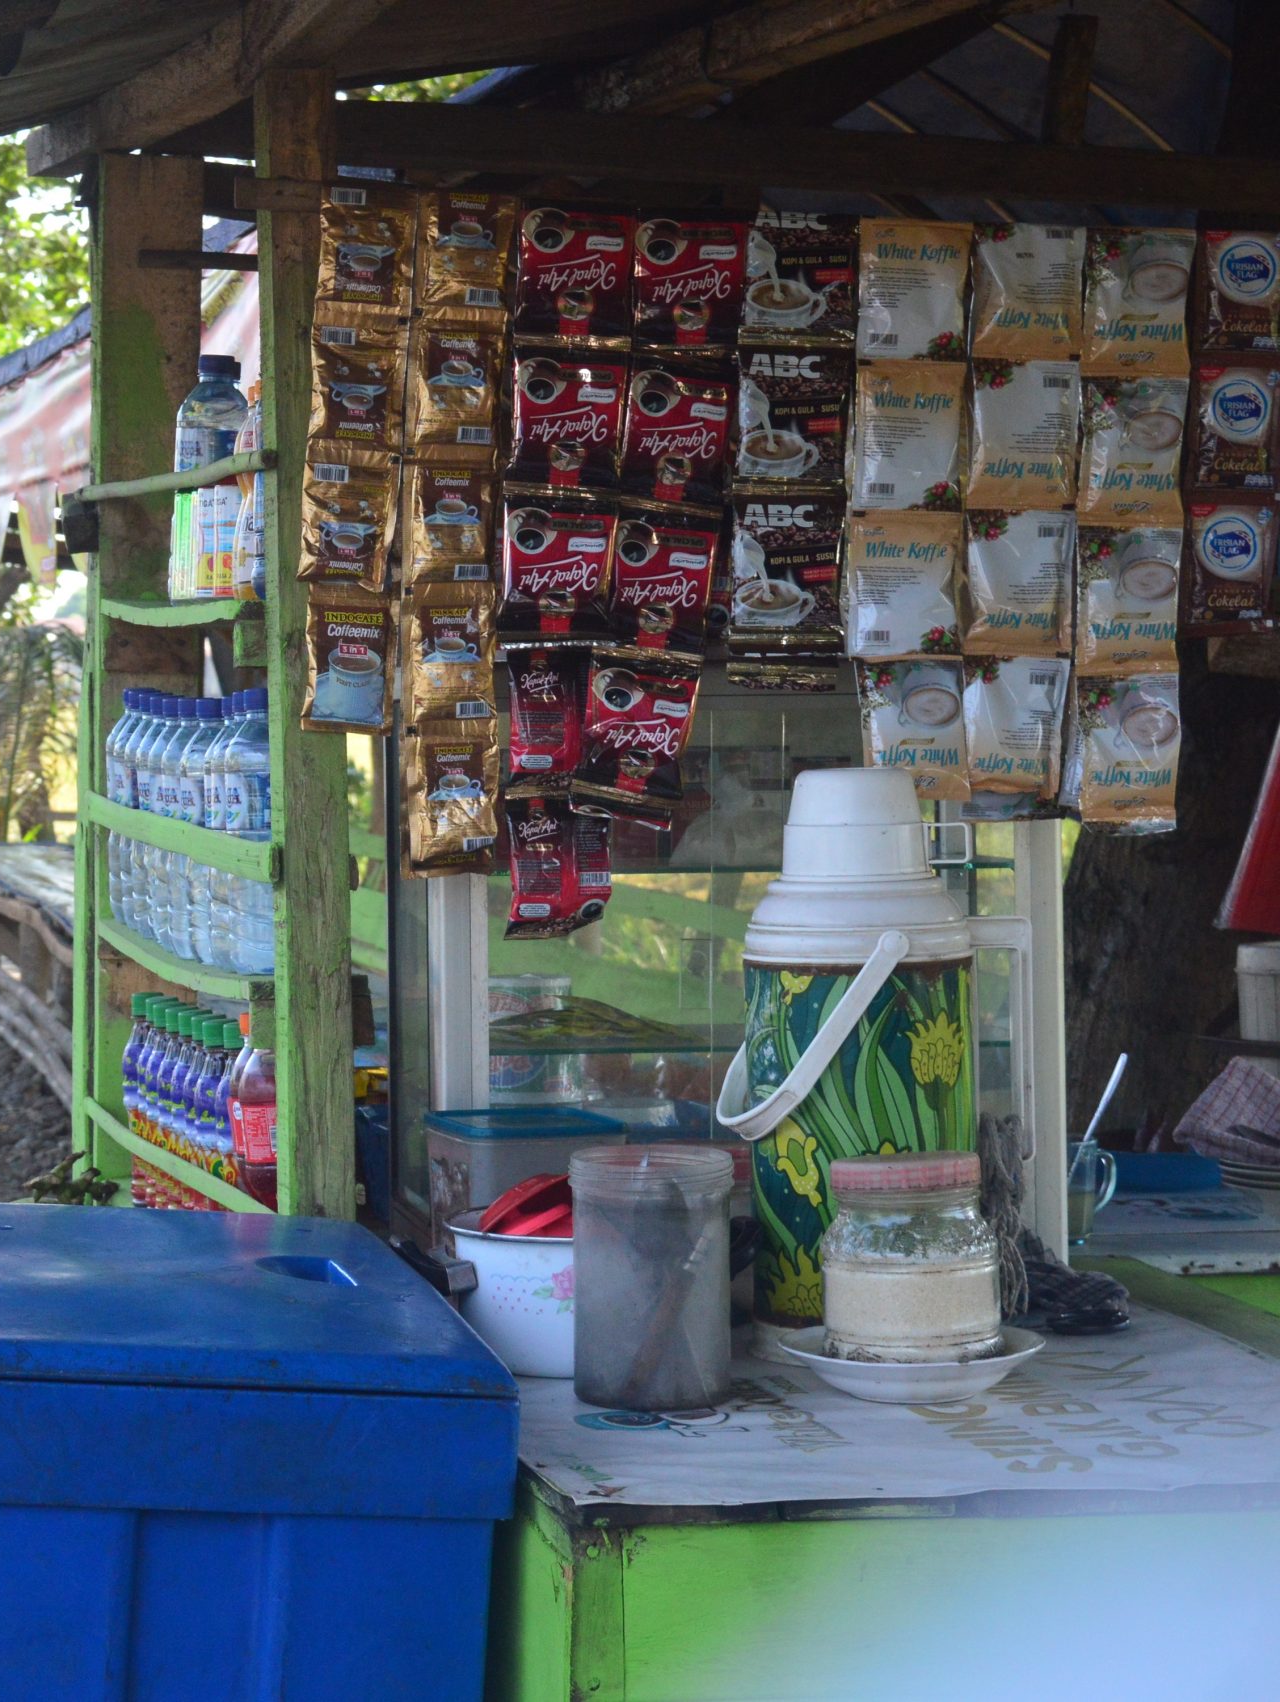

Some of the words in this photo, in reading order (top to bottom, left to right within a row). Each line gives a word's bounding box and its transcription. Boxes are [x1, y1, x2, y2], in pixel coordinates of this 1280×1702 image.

[451, 200, 486, 210] Coffeemix
[755, 211, 827, 230] ABC
[876, 244, 917, 260] White
[920, 244, 960, 264] Koffie
[570, 260, 616, 291] Kapal
[1232, 262, 1263, 271] FRISIAN
[1237, 270, 1257, 279] FLAG
[537, 267, 568, 292] Api
[683, 268, 731, 300] Kapal
[652, 278, 683, 303] Api
[1141, 321, 1183, 341] White
[749, 353, 821, 378] ABC
[821, 404, 839, 413] SUSU
[874, 392, 910, 409] White
[914, 393, 952, 413] Koffie
[1223, 401, 1255, 410] FRISIAN
[1228, 408, 1249, 417] FLAG
[339, 421, 375, 430] Coffeemix
[529, 418, 560, 443] Api
[560, 412, 607, 443] Kapal
[640, 431, 669, 456] Api
[669, 427, 717, 459] Kapal
[984, 461, 1023, 476] Koffie
[1025, 463, 1064, 477] White
[434, 477, 470, 487] Coffeemix
[1135, 472, 1177, 491] White
[743, 503, 814, 527] ABC
[1214, 539, 1245, 547] FRISIAN
[1219, 546, 1239, 555] FLAG
[816, 552, 834, 561] SUSU
[866, 542, 904, 558] White
[908, 543, 947, 563] Koffie
[329, 560, 363, 570] Coffeemix
[518, 568, 548, 592] Api
[549, 560, 598, 592] Kapal
[620, 581, 650, 604] Api
[650, 577, 698, 608] Kapal
[432, 615, 467, 625] Coffeemix
[986, 612, 1022, 629] Koffie
[328, 623, 379, 638] Coffeemix
[1134, 622, 1176, 640] White
[341, 644, 348, 654] 3
[349, 645, 359, 655] in
[521, 673, 543, 690] Kapal
[543, 672, 559, 686] Api
[604, 725, 634, 749] Api
[633, 724, 680, 756] Kapal
[436, 752, 470, 762] Coffeemix
[925, 749, 959, 766] White
[975, 756, 1014, 774] Koffie
[1091, 766, 1130, 786] Koffie
[1133, 768, 1172, 783] White
[519, 822, 541, 840] Kapal
[541, 819, 559, 833] Api
